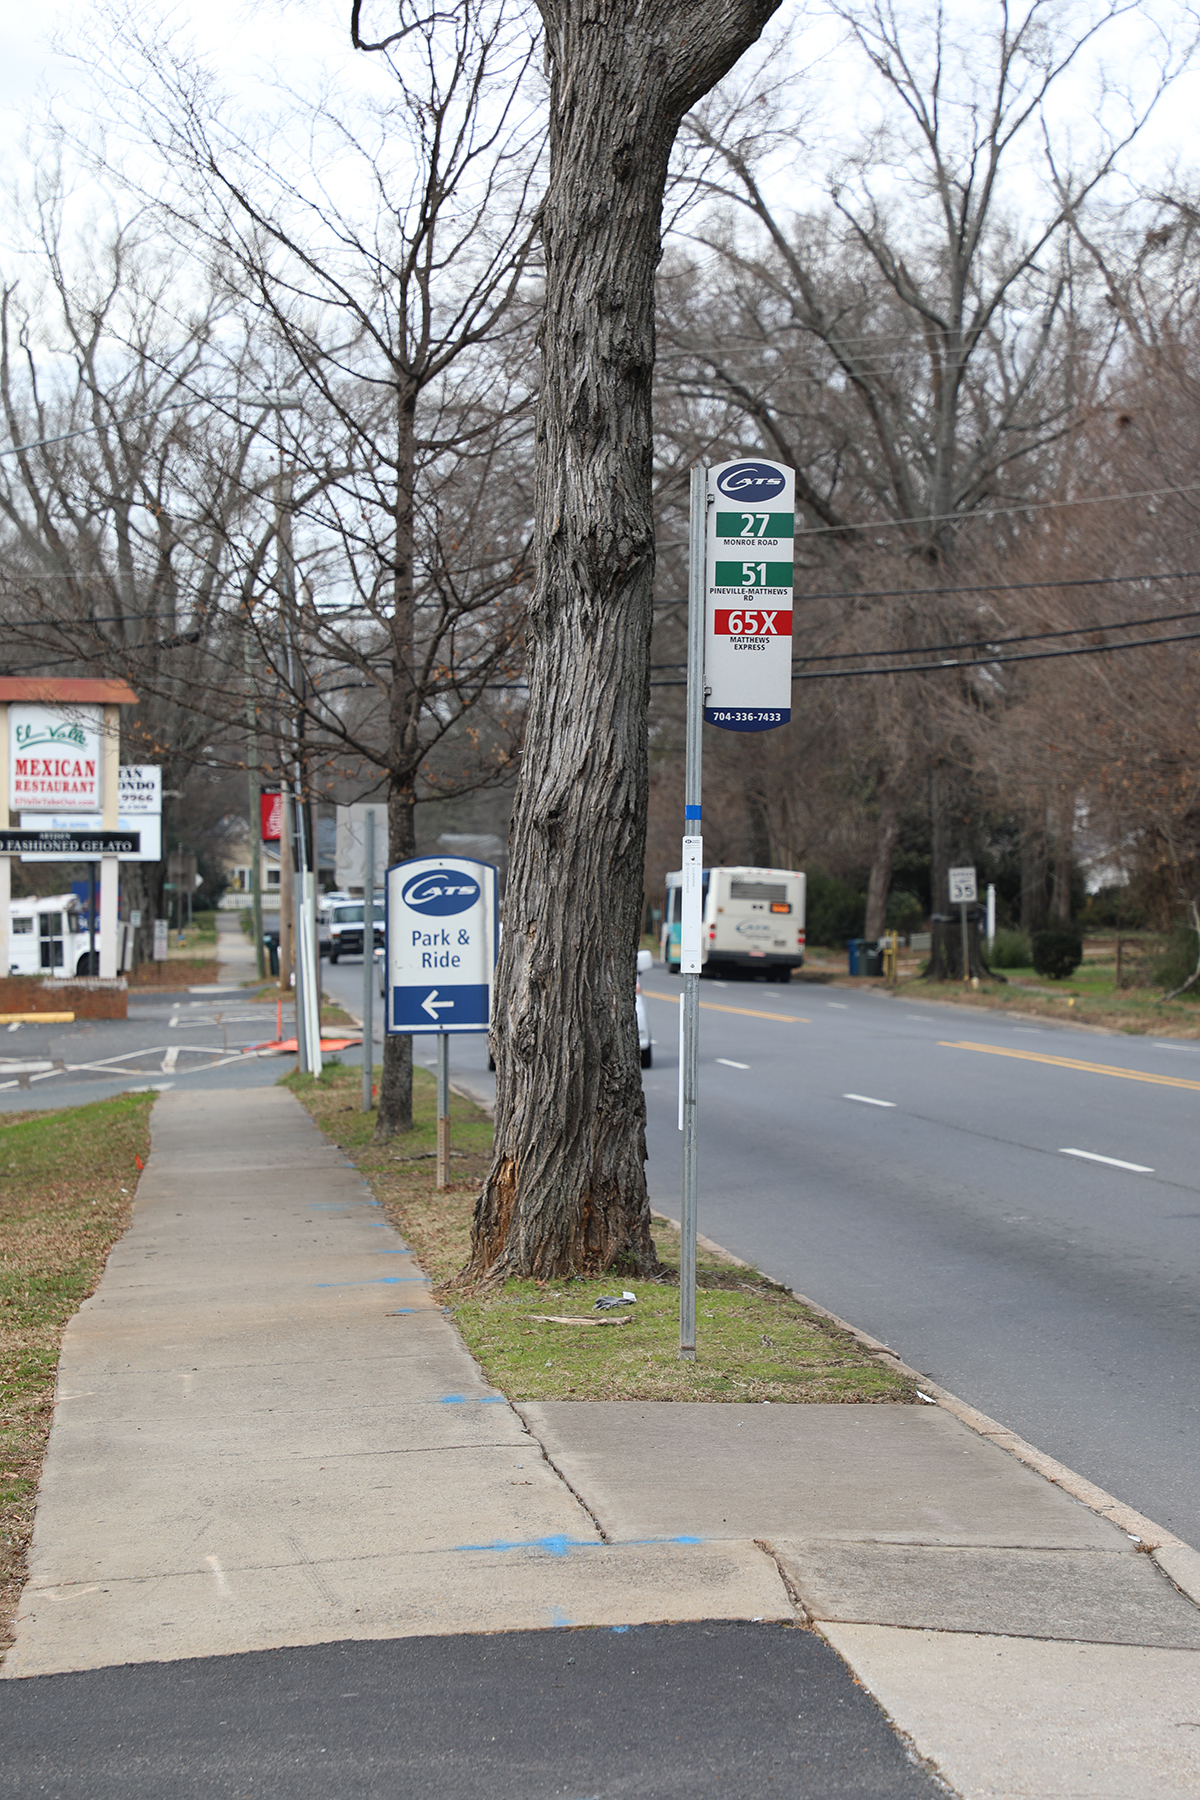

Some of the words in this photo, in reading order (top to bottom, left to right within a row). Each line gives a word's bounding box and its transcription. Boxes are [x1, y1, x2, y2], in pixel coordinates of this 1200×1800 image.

[720, 467, 782, 492] CATS
[740, 513, 770, 537] 27
[741, 562, 767, 586] 51
[709, 587, 788, 595] PINEVILLE-MATTHEWS
[743, 594, 754, 602] RD
[728, 610, 778, 634] 65X
[729, 636, 770, 644] MATTHEWS
[733, 643, 766, 651] EXPRESS
[713, 712, 782, 722] 704-336-7433
[45, 723, 88, 746] Valle
[15, 759, 96, 777] MEXICAN
[15, 780, 95, 793] RESTAURANT
[7, 840, 79, 852] FASHIONED
[81, 840, 132, 852] GELATO
[404, 874, 478, 905] CATS
[953, 884, 975, 899] 35
[412, 929, 451, 946] Park
[457, 928, 471, 946] &
[421, 950, 462, 969] Ride
